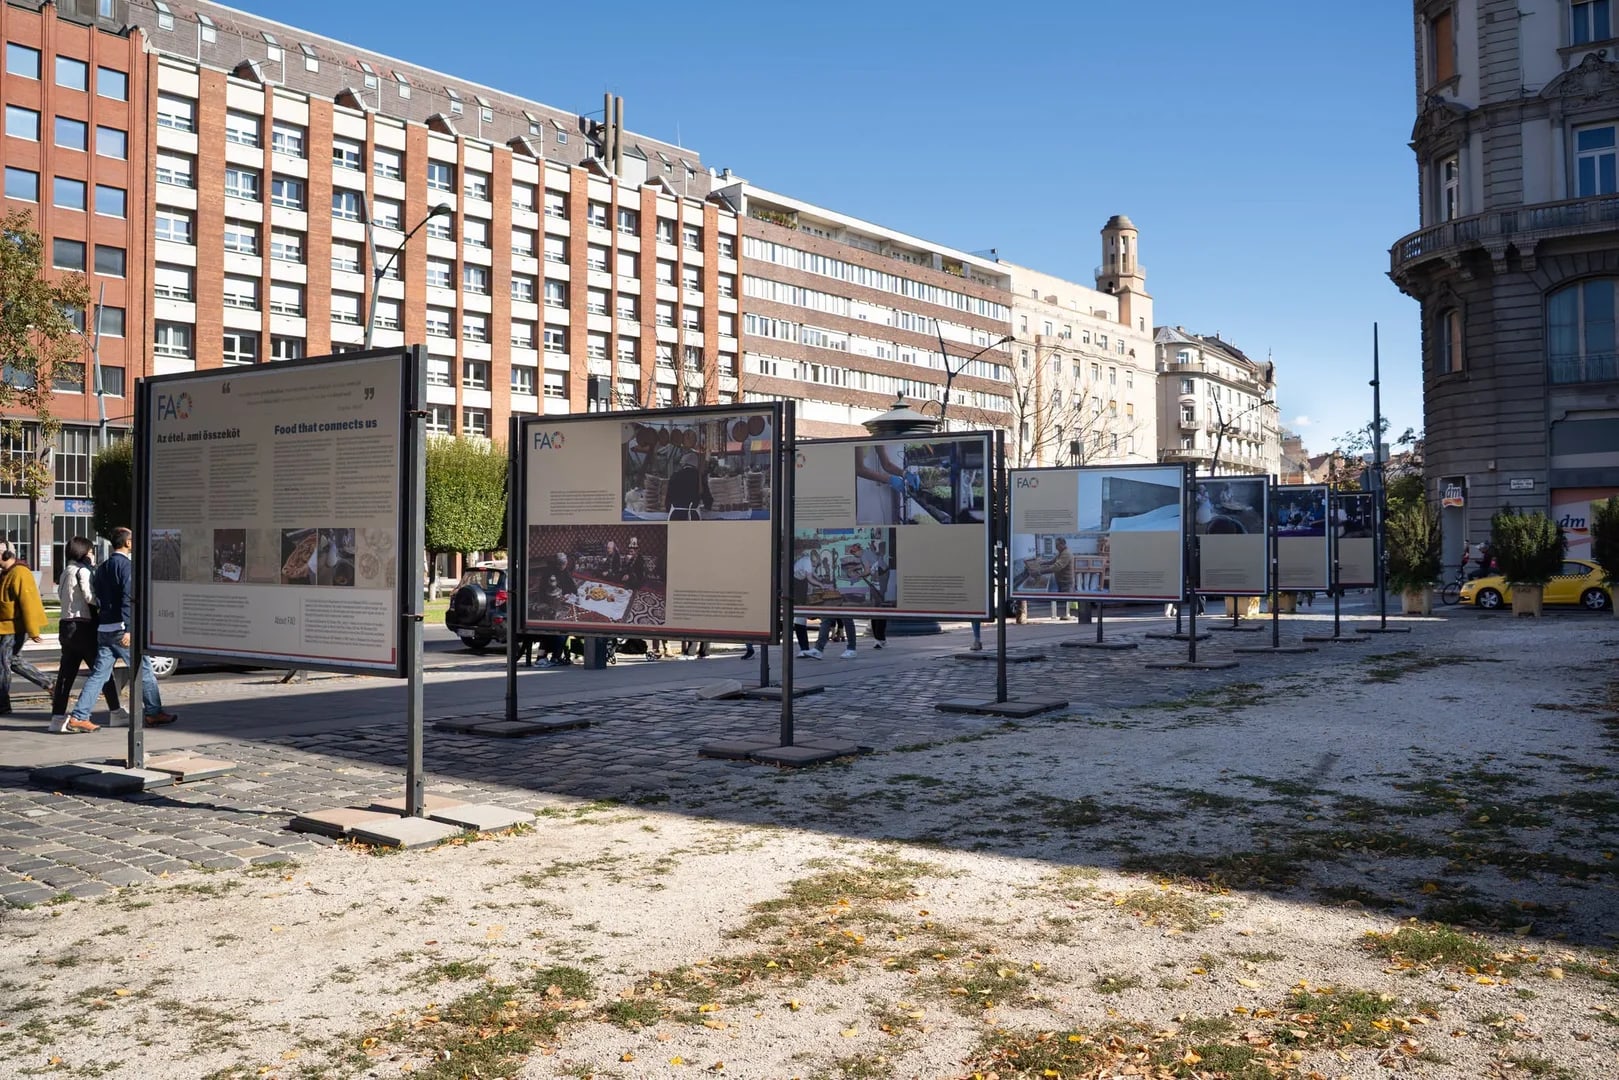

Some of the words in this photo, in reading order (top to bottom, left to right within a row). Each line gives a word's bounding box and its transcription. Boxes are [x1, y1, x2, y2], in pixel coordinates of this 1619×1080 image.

[157, 392, 193, 421] FAO
[274, 424, 297, 435] Food
[298, 422, 317, 433] that
[318, 419, 364, 432] connects
[365, 419, 378, 429] us
[157, 433, 167, 443] Az
[168, 431, 186, 443] étel,
[187, 430, 202, 441] ami
[203, 428, 241, 440] összeköt
[534, 431, 566, 450] FAO
[1017, 477, 1039, 489] FAO
[1445, 482, 1461, 499] dm
[1560, 514, 1585, 528] dm
